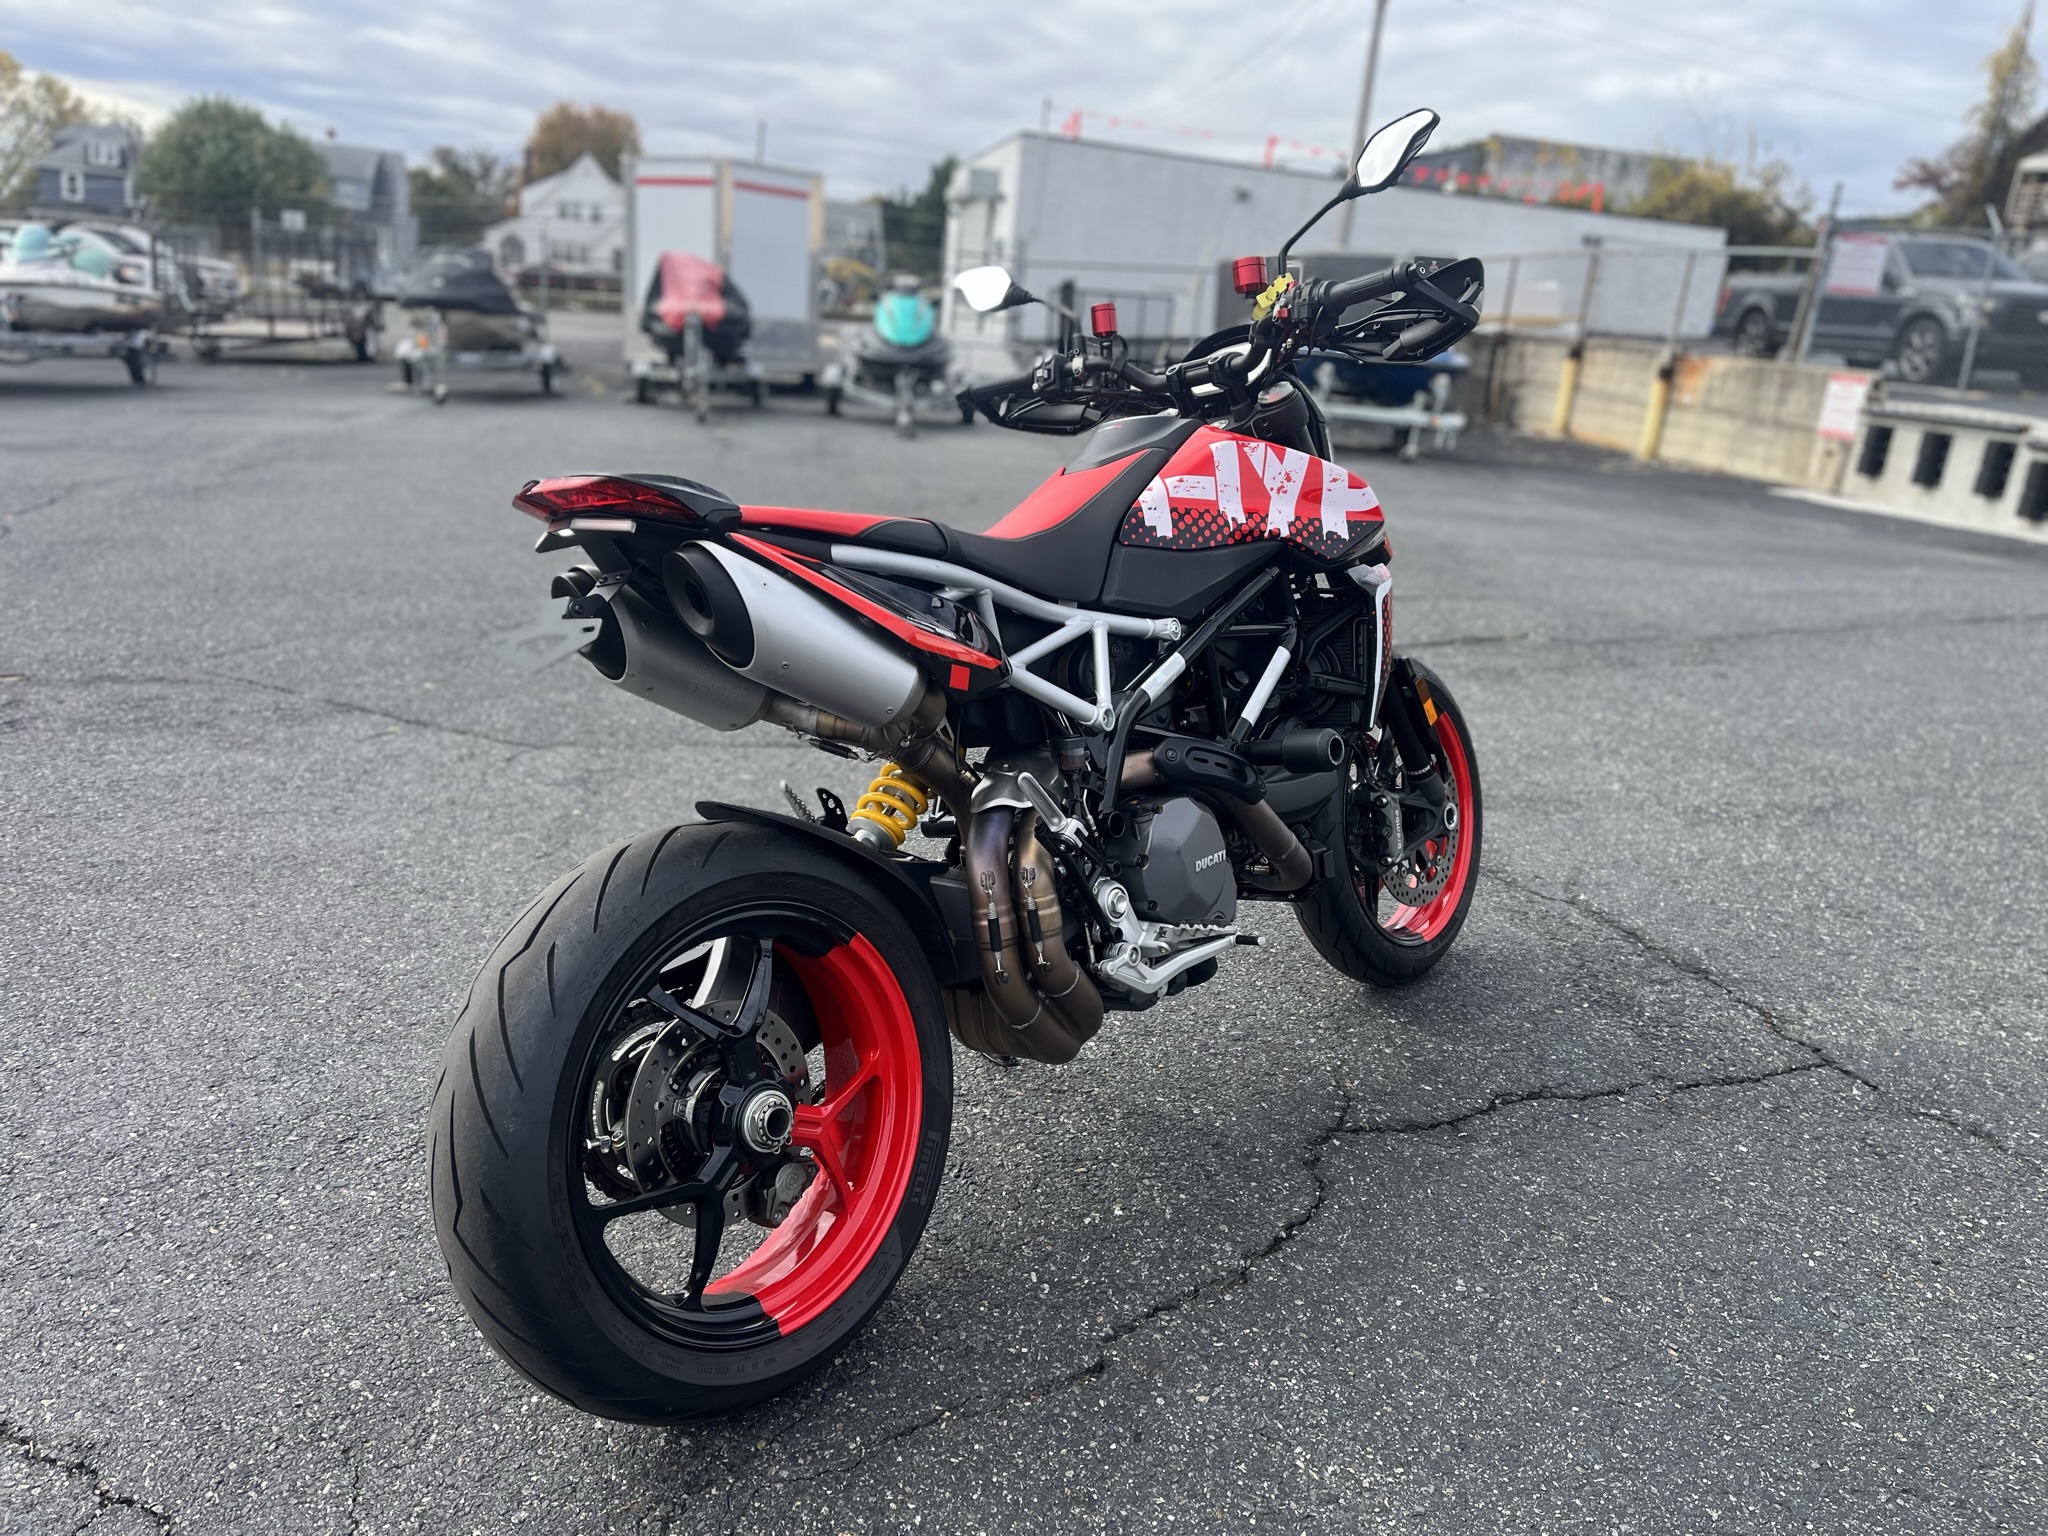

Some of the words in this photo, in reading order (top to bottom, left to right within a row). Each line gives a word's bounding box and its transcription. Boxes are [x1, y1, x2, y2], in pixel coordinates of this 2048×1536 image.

[1394, 810, 1402, 850] brembo
[1195, 849, 1227, 873] DUCATI
[910, 1130, 943, 1206] PIRELLI
